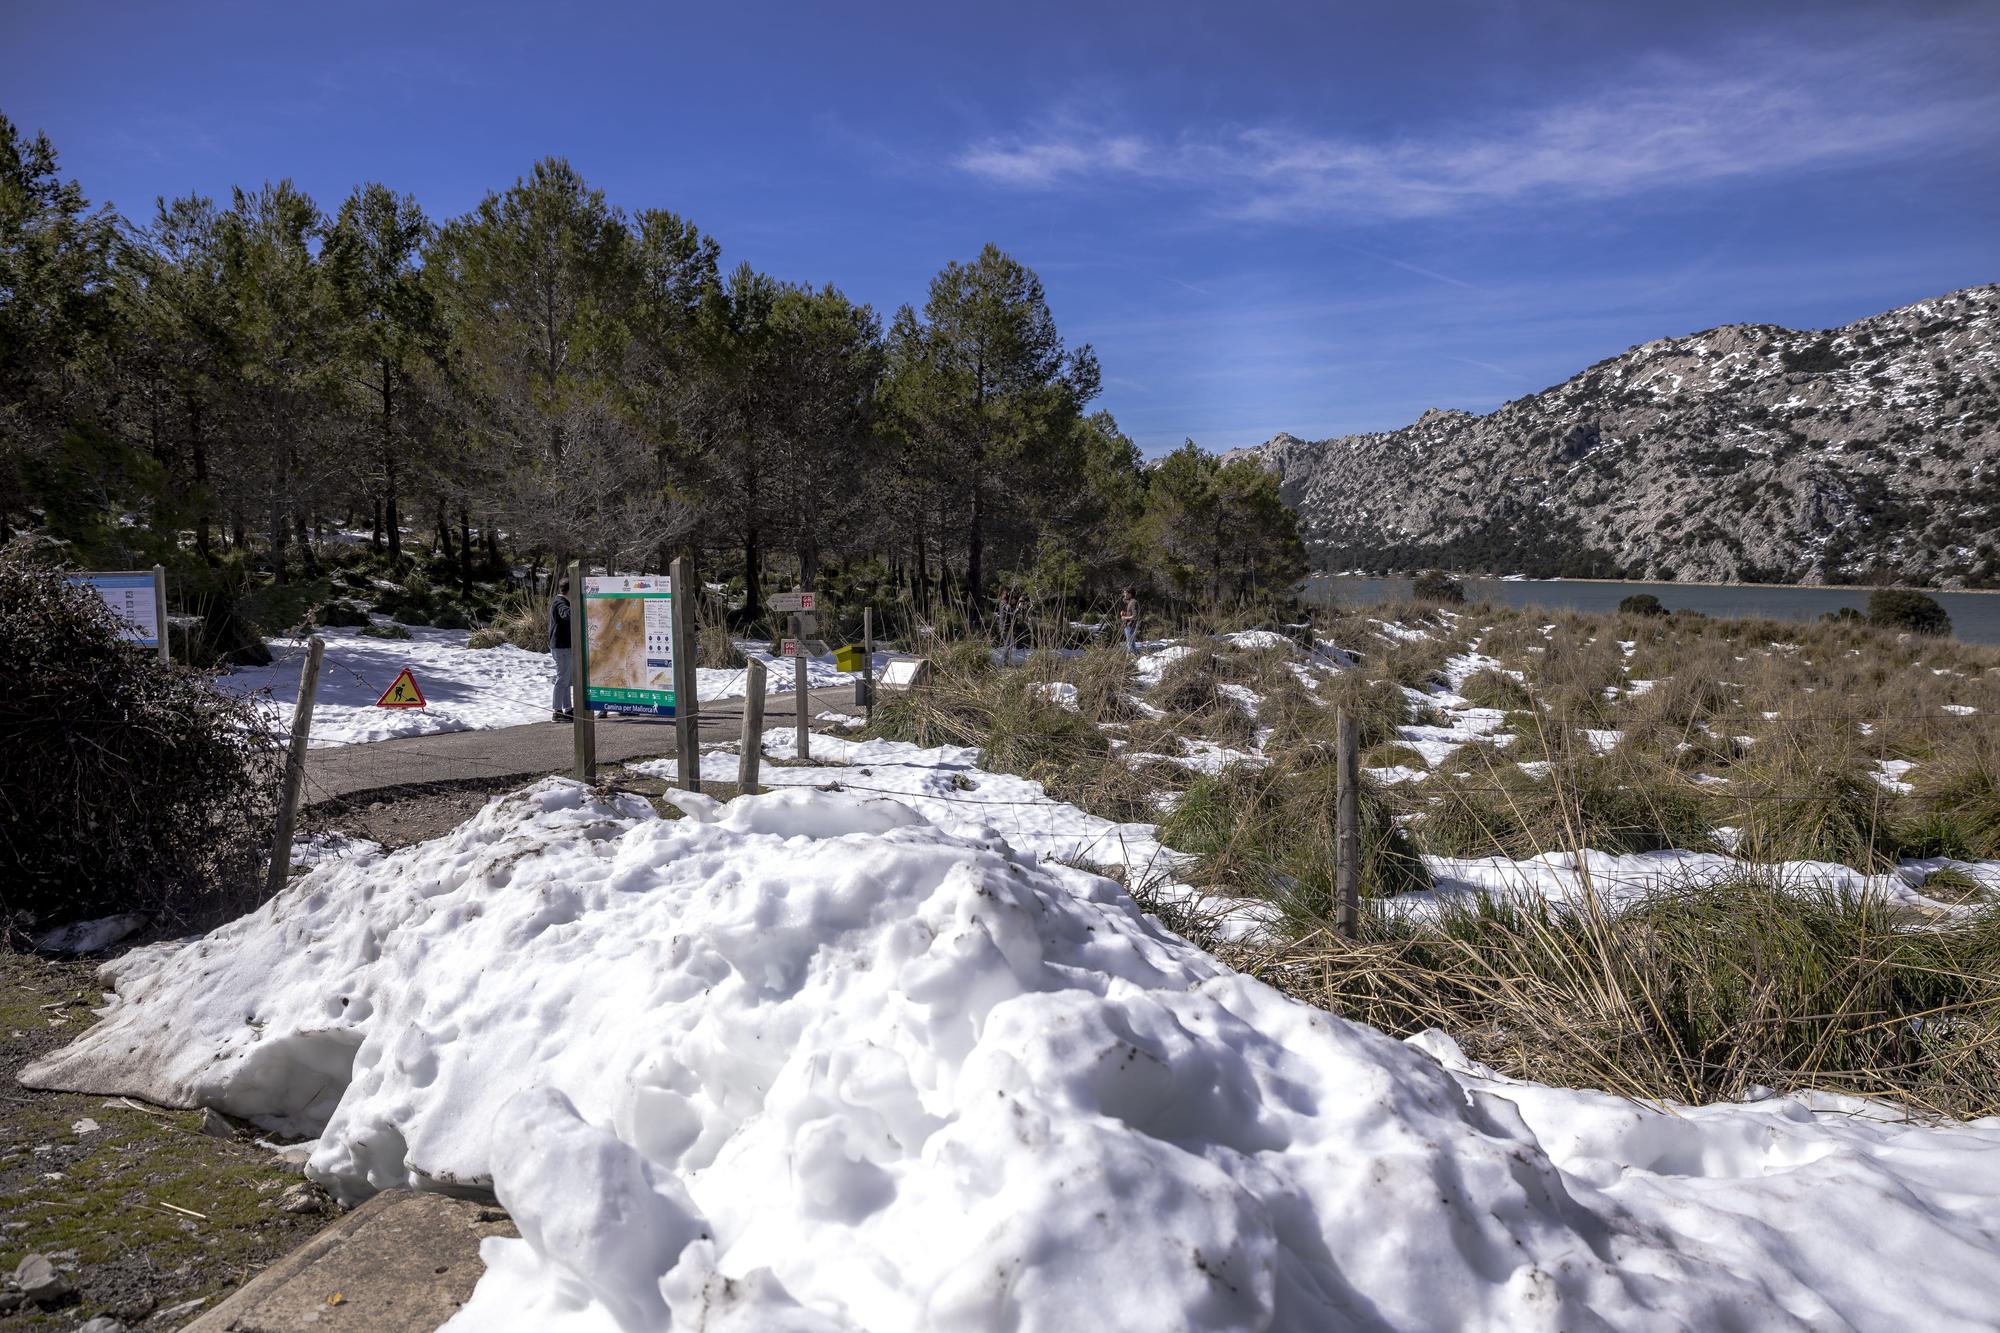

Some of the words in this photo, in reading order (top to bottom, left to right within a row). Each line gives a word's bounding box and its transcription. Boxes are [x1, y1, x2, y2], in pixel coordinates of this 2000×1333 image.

[604, 703, 622, 711] Camina
[623, 705, 632, 713] per
[632, 705, 652, 713] Mallorca
